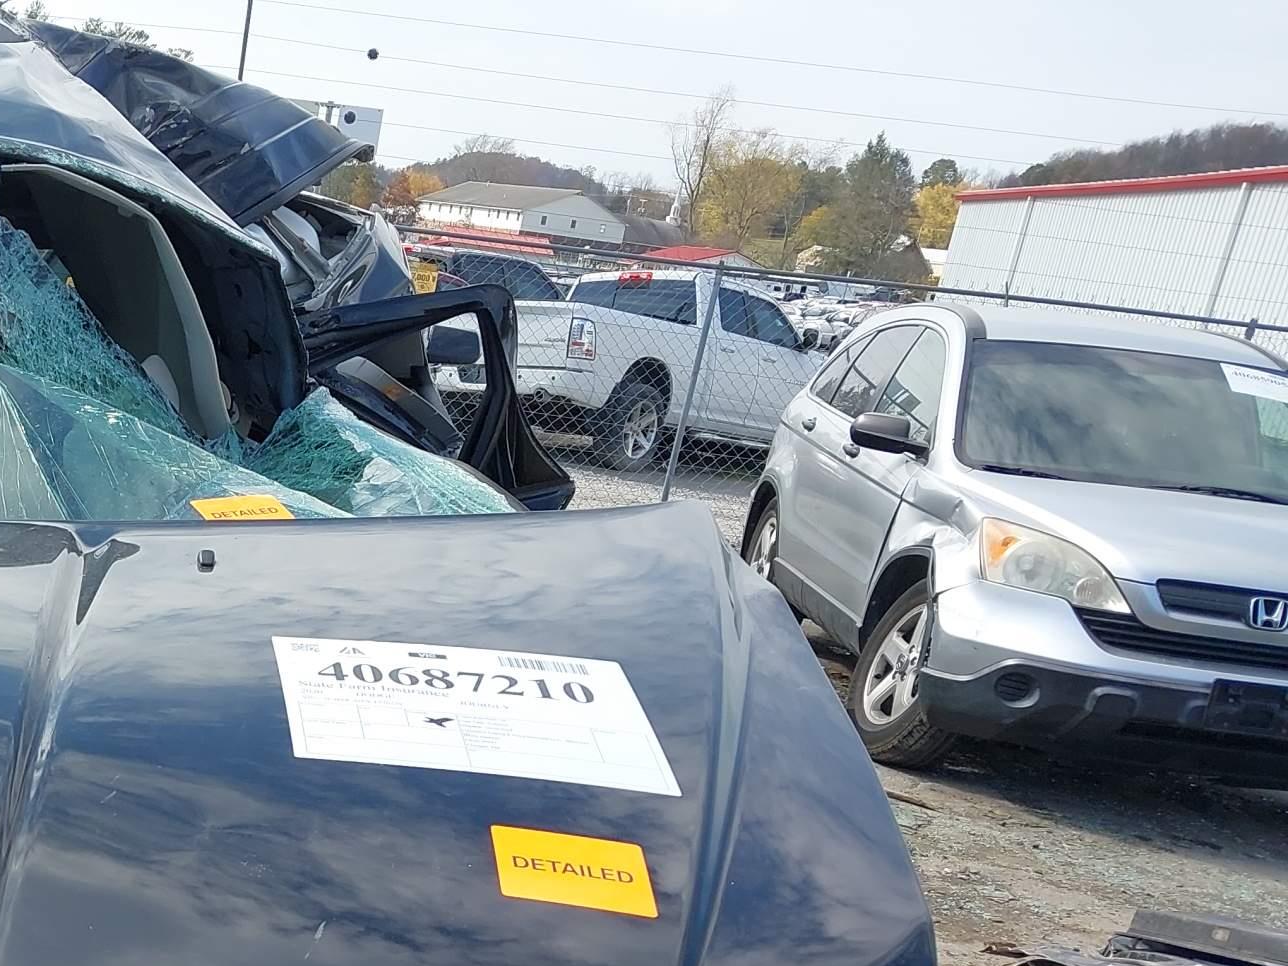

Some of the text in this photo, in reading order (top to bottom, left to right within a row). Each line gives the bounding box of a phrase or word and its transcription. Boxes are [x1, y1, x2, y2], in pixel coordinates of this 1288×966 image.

[211, 507, 279, 519] DETAILED
[318, 662, 595, 704] 40687210
[511, 855, 635, 884] DETAILED
